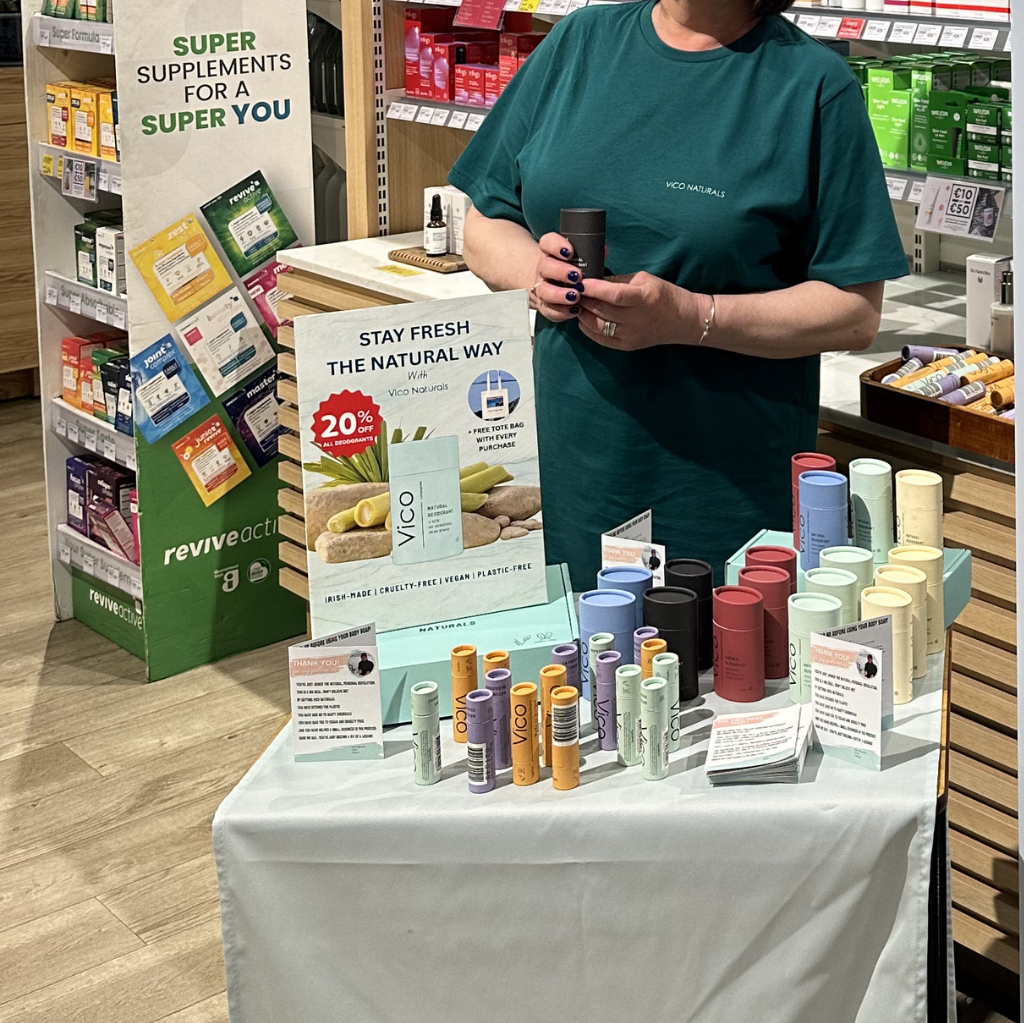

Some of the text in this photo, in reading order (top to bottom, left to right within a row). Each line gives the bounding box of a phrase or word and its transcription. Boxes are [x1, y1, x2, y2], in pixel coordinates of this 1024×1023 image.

[52, 27, 100, 43] Super Formula
[173, 31, 257, 56] SUPER
[137, 53, 292, 84] SUPPLEMENTS
[185, 81, 250, 102] FOR A
[141, 99, 291, 136] SUPER YOU
[229, 184, 256, 206] revive
[666, 180, 726, 198] VICO NATURALS
[953, 187, 973, 200] €10
[950, 202, 970, 215] €50
[360, 320, 470, 346] STAY FRESH
[150, 349, 176, 370] complex
[327, 340, 504, 376] THE NATURAL WAY
[246, 372, 277, 398] master
[408, 370, 428, 380] With
[388, 382, 449, 397] Vico Naturals
[321, 410, 374, 438] 20%
[357, 425, 374, 433] OFF
[473, 426, 490, 434] FREE
[491, 423, 509, 432] TOTE
[335, 436, 374, 446] DEODORANTS
[476, 432, 517, 443] WITH EVERY
[479, 441, 516, 452] PURCHASE
[396, 491, 416, 547] Vico
[164, 518, 277, 566] reviveacti
[325, 563, 532, 603] IRISH-MADE CRUELTY-FREE VEGAN PLASTIC-FREE
[90, 588, 143, 630] reviveactive
[419, 620, 476, 633] NATURALS
[513, 704, 528, 744] Vico
[597, 699, 610, 739] Vico
